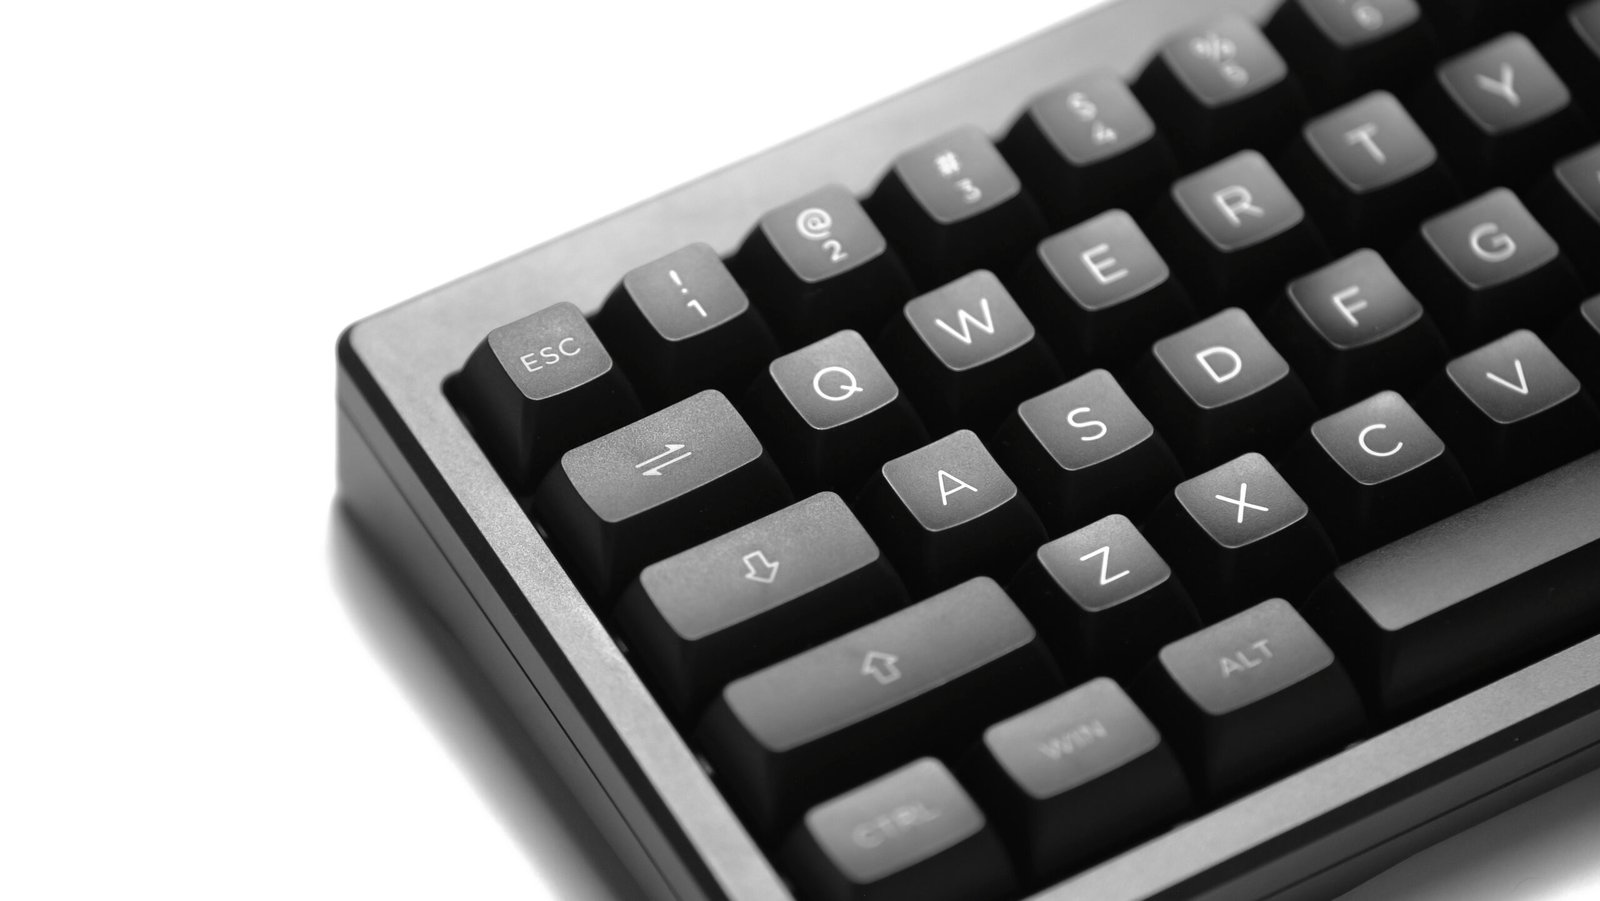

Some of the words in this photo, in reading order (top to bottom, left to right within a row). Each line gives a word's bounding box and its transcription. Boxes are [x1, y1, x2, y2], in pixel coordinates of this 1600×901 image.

[1476, 62, 1521, 108] Y
[1091, 121, 1117, 145] 4
[1343, 123, 1386, 165] T
[934, 152, 960, 176] #
[957, 178, 982, 203] 3
[1213, 185, 1264, 226] R
[796, 208, 832, 238] @
[823, 240, 848, 262] 2
[1468, 222, 1516, 261] G
[669, 269, 689, 294] !
[1080, 244, 1128, 286] E
[687, 300, 707, 317] 1
[935, 298, 995, 344] W
[1332, 286, 1368, 326] F
[519, 337, 581, 373] ESC
[1196, 346, 1243, 383] D
[813, 366, 864, 401] Q
[1486, 359, 1529, 395] V
[1067, 406, 1108, 442] S
[1358, 423, 1404, 457] C
[937, 470, 979, 506] A
[1215, 482, 1269, 524] X
[1080, 545, 1130, 586] Z
[1219, 639, 1274, 678] ALT
[1038, 719, 1108, 761] WIN
[852, 802, 943, 849] CTRL
